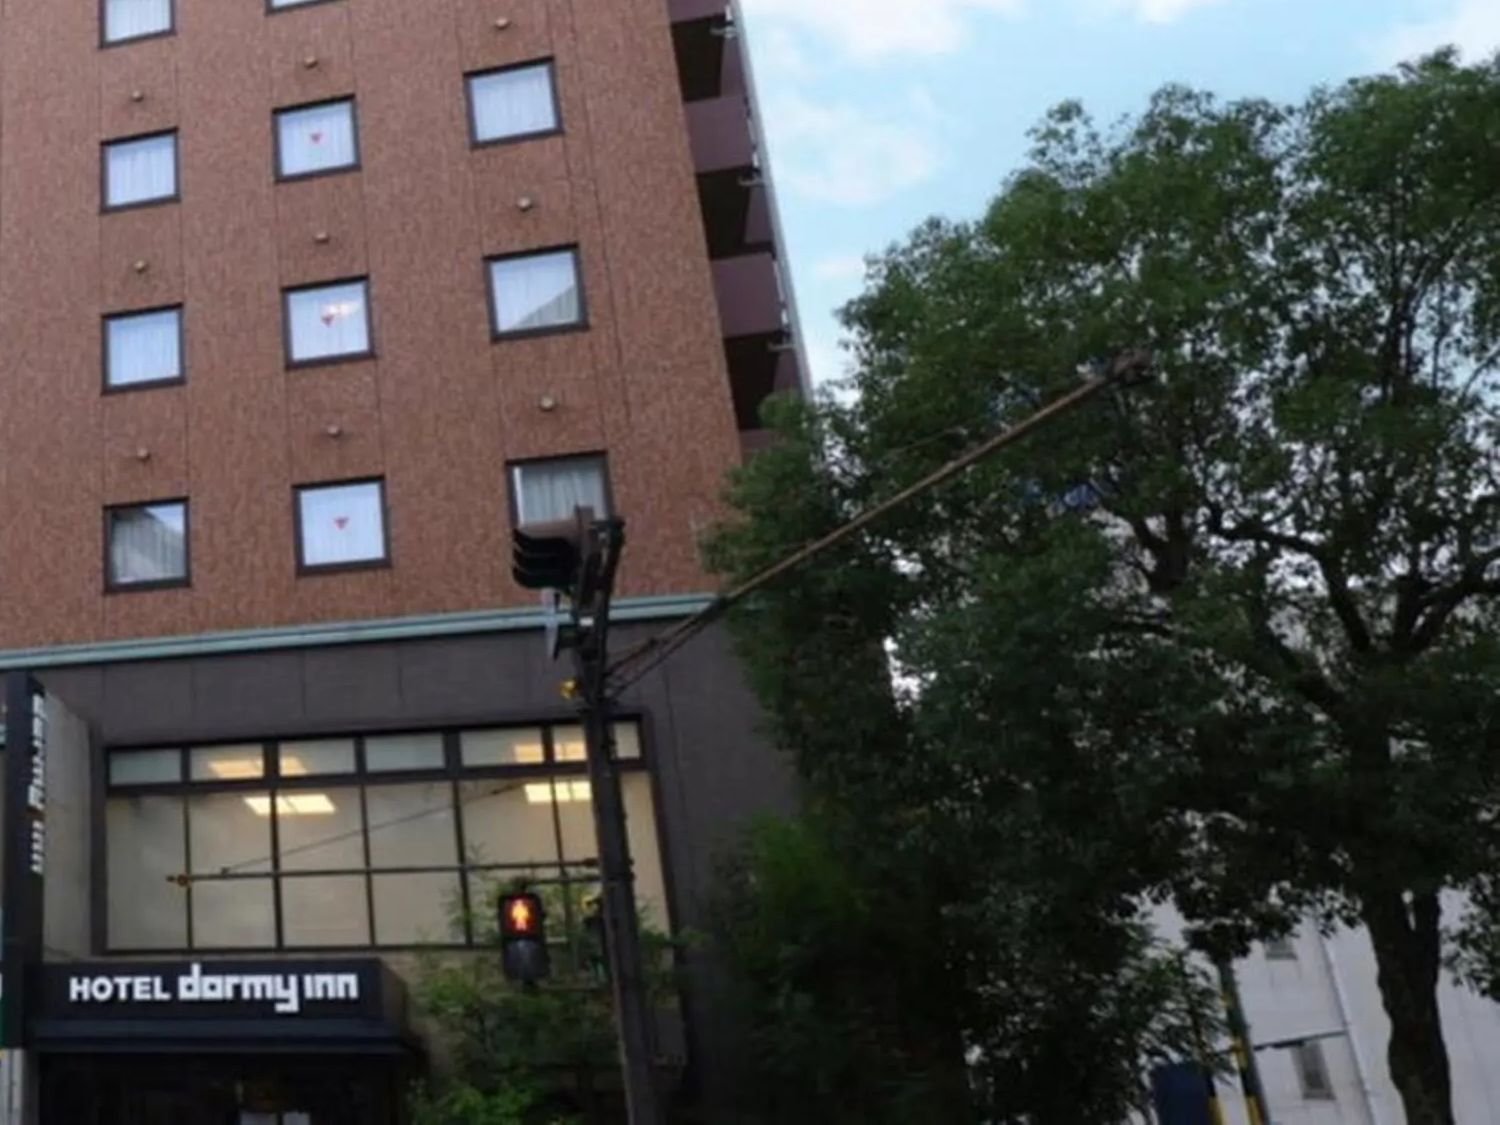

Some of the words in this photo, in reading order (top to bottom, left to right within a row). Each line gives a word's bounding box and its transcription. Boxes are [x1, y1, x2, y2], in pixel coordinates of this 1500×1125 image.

[69, 976, 172, 1001] HOTEL
[178, 962, 299, 1013] dormy
[303, 974, 359, 1000] inn
